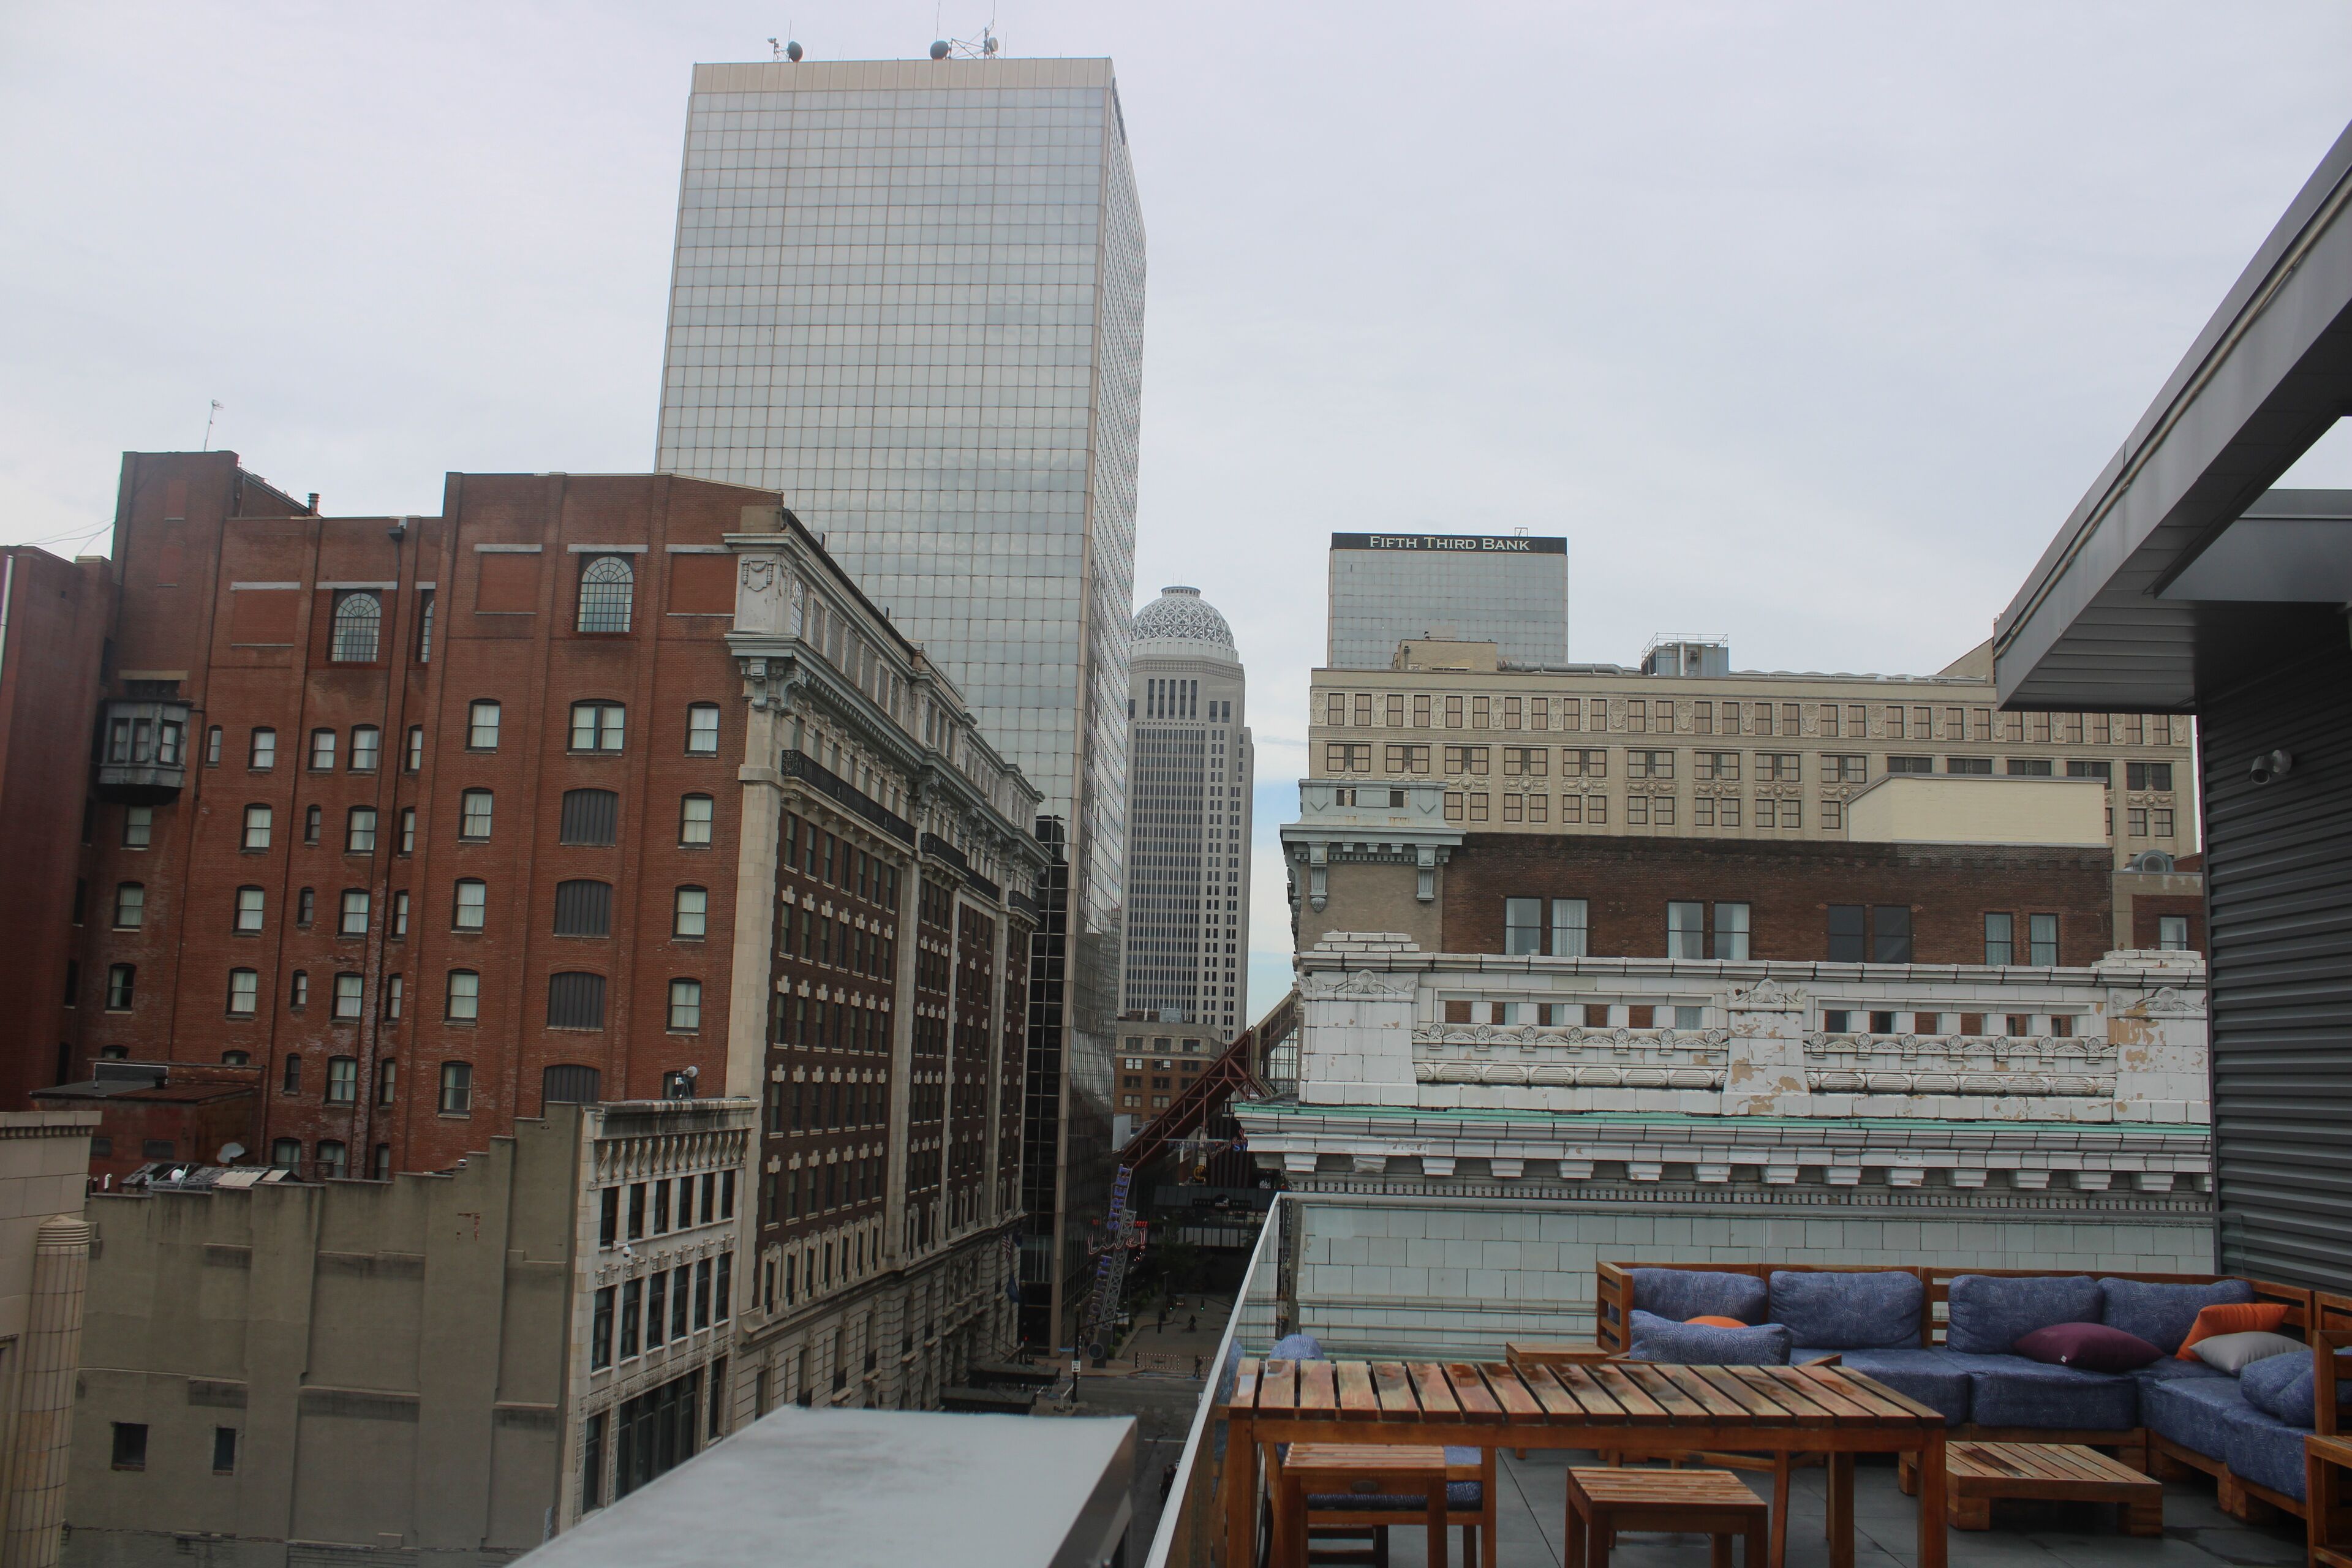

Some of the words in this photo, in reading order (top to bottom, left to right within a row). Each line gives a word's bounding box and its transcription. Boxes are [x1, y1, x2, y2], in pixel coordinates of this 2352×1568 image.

[1370, 535, 1418, 549] FIFTH
[1423, 537, 1477, 549] THIRD
[1482, 538, 1531, 551] BANK
[1106, 1163, 1132, 1231] STREET
[1087, 1227, 1147, 1256] Live!
